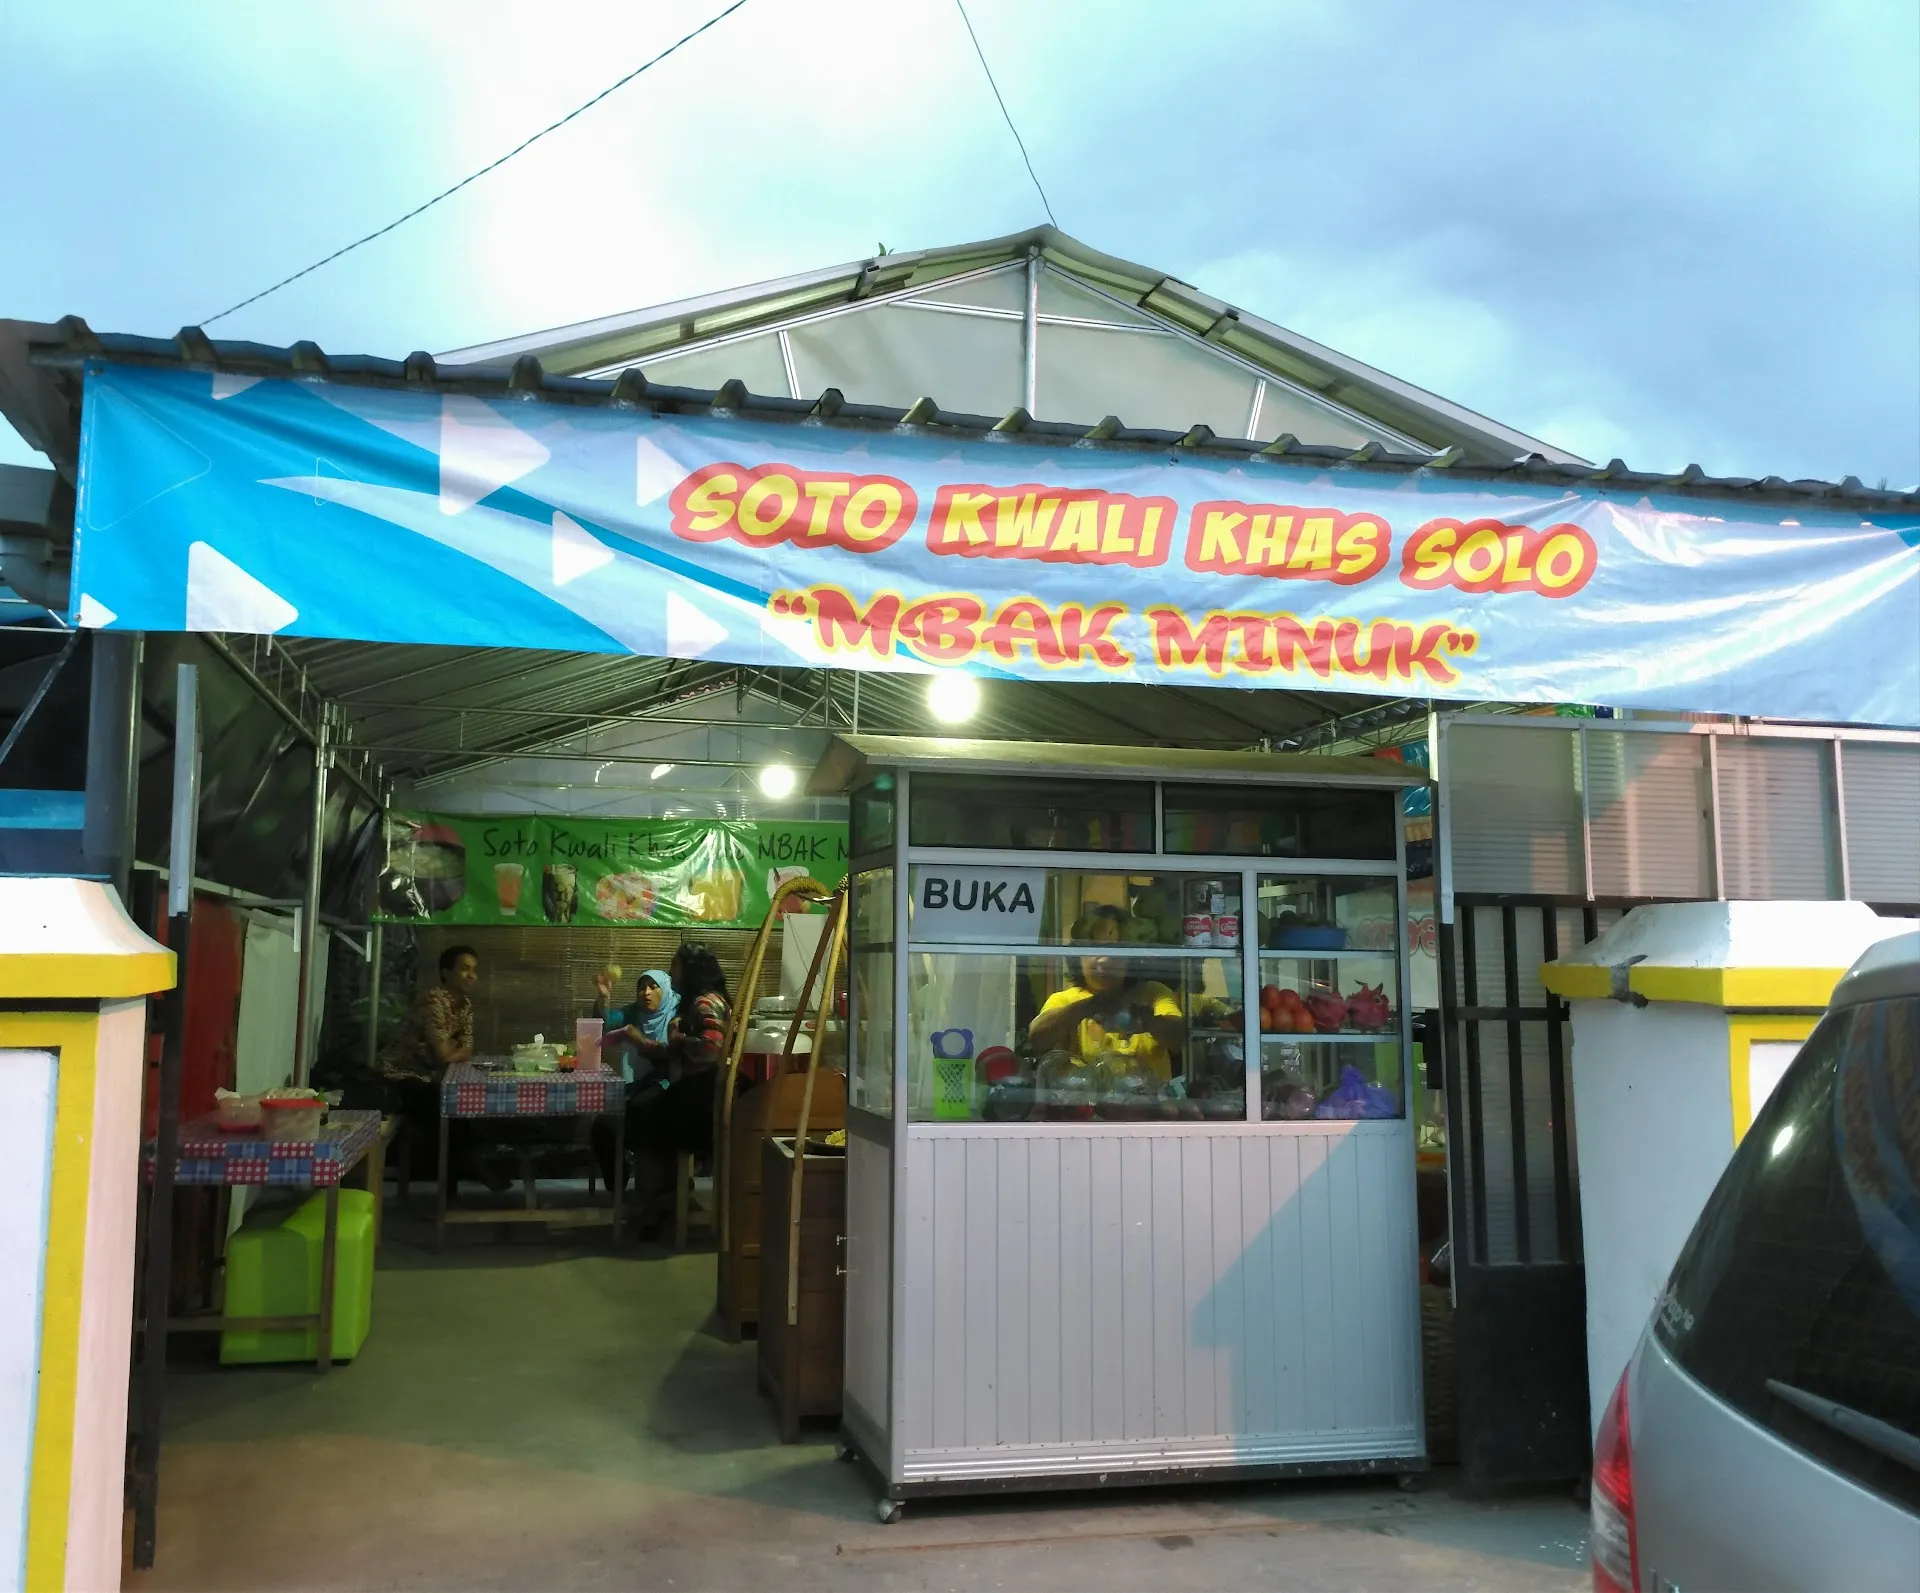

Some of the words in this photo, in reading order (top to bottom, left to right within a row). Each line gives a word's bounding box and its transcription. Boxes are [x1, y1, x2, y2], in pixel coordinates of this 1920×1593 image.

[684, 472, 904, 543] SOTO
[942, 492, 1164, 559] KWALI
[1197, 510, 1379, 576] KHAS
[1412, 526, 1586, 590] SOLO
[482, 827, 538, 858] Soto
[550, 830, 617, 859] Kwali
[758, 832, 829, 862] MBAK
[923, 878, 1035, 913] BUKA
